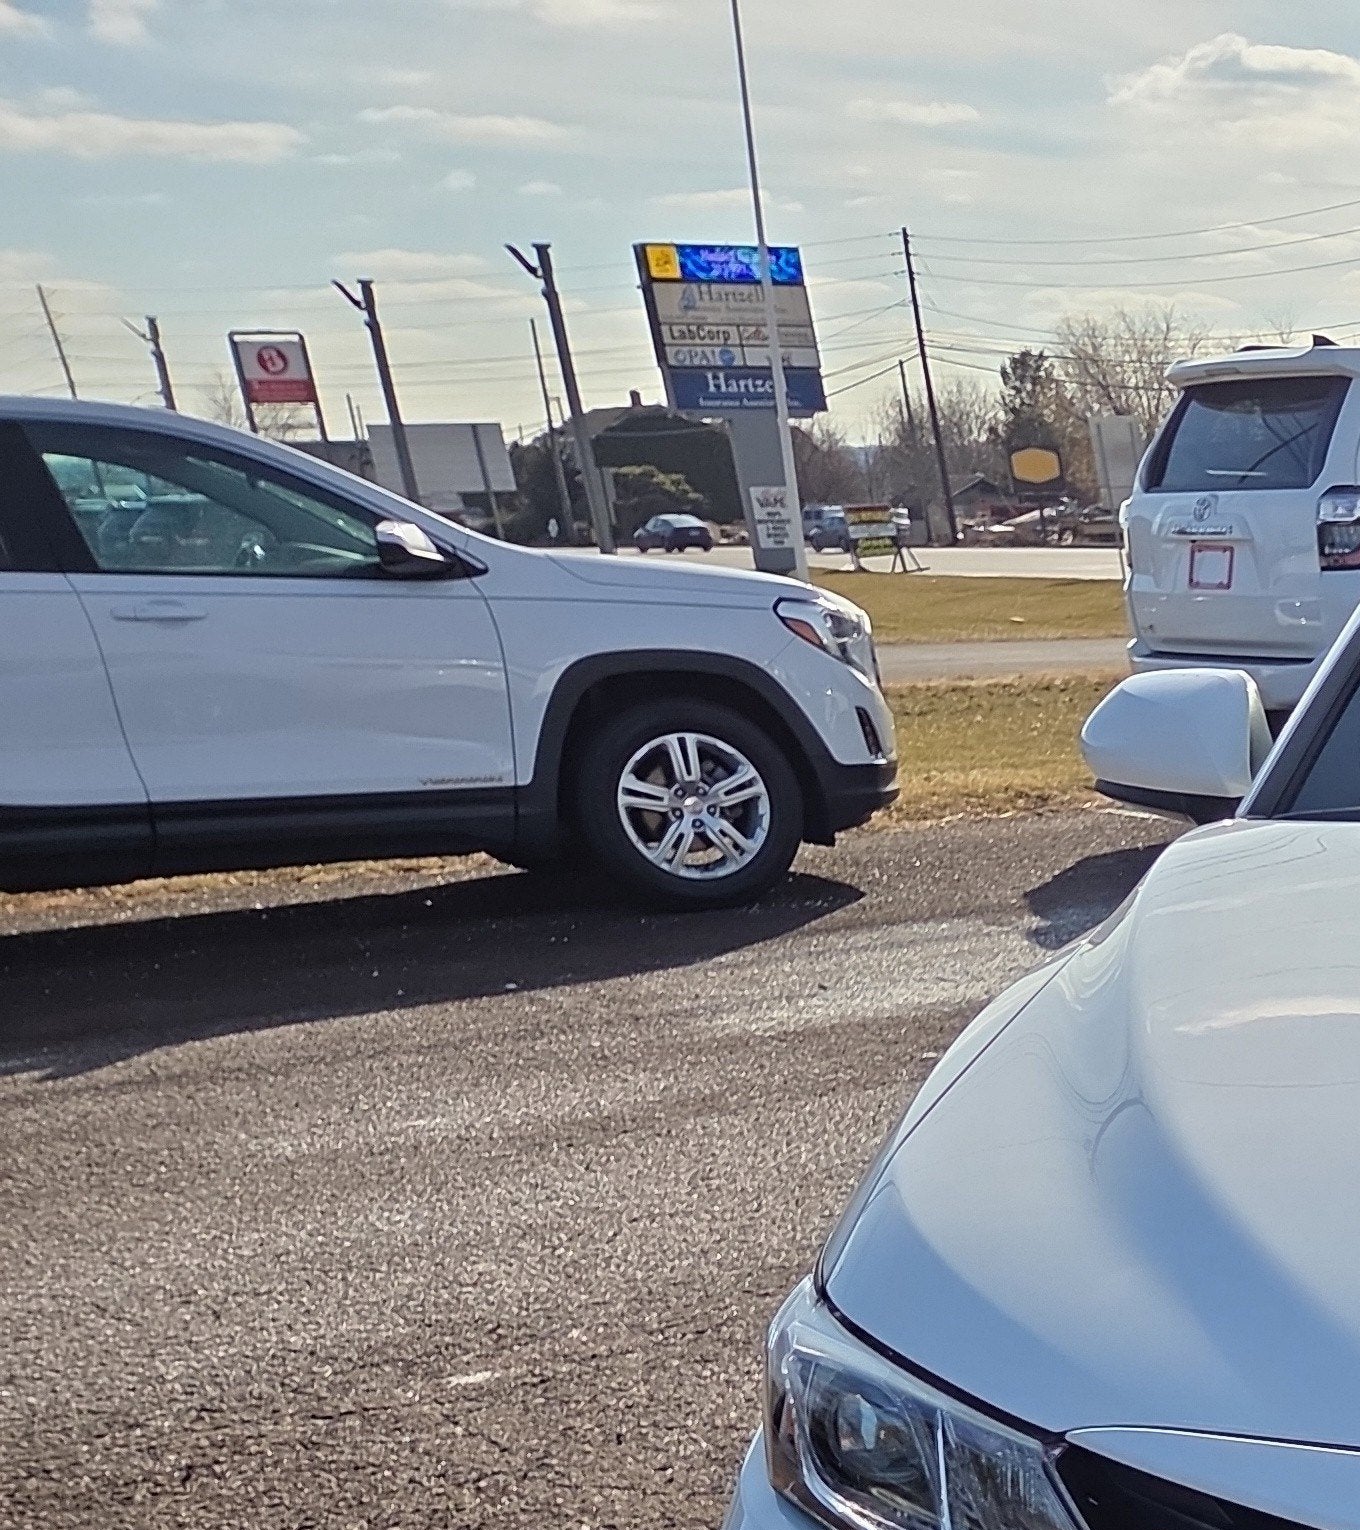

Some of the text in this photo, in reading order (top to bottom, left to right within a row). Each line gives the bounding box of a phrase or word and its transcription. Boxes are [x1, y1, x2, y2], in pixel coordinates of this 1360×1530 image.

[697, 283, 766, 303] Hartzell
[670, 324, 731, 345] LabCorp
[704, 371, 777, 393] Hartze
